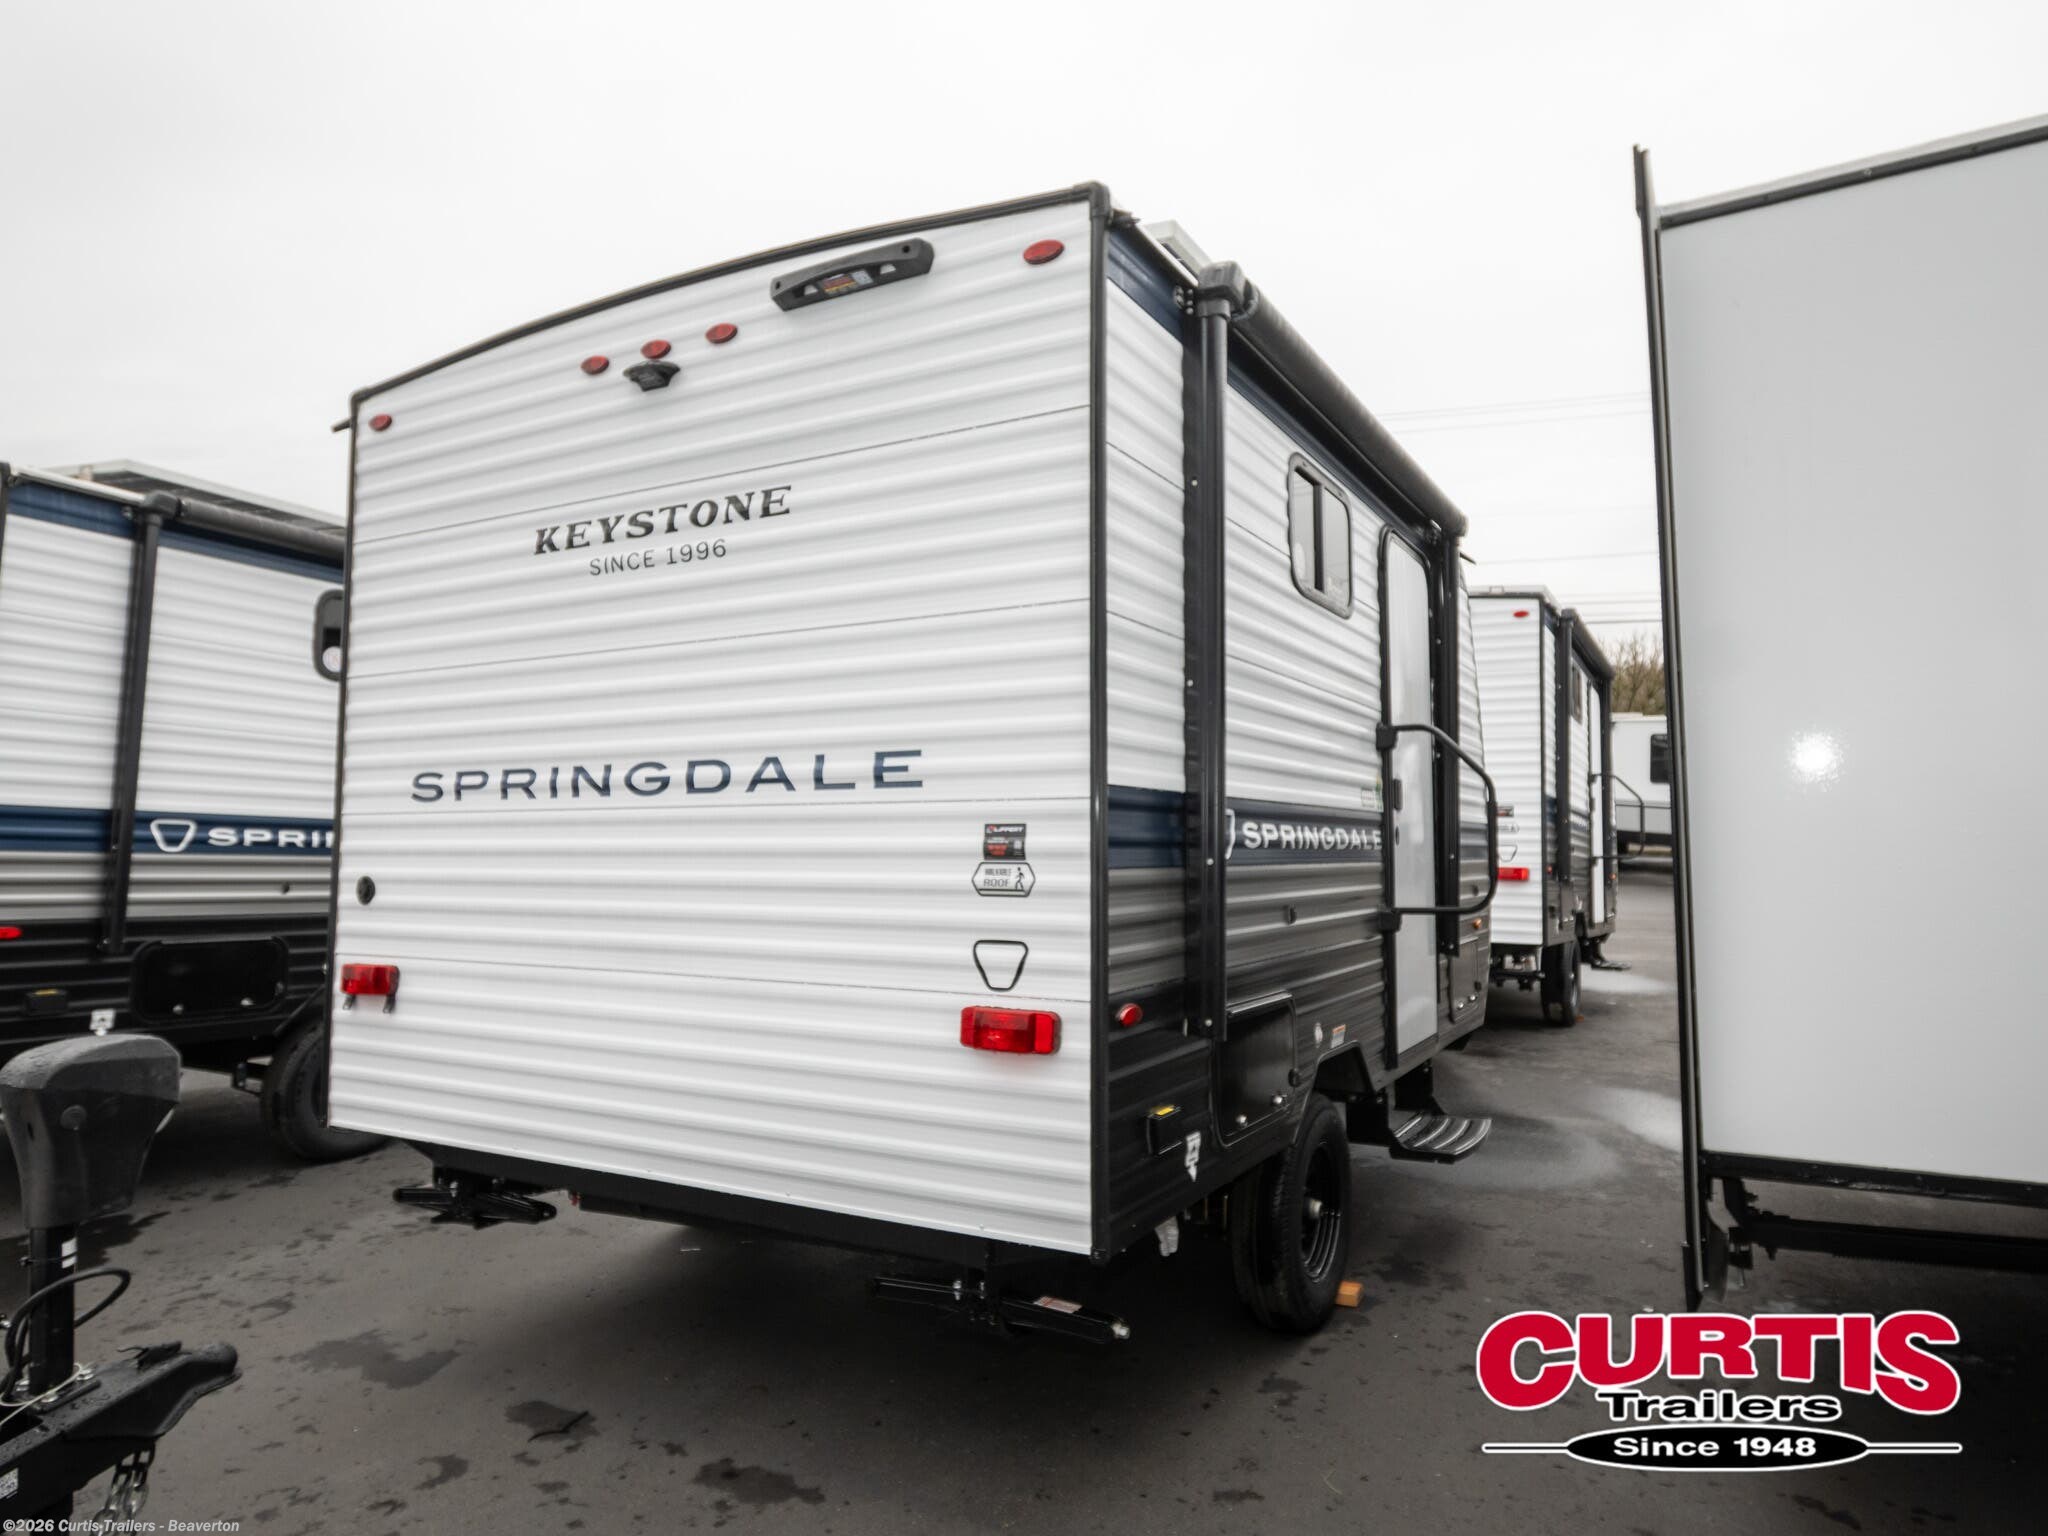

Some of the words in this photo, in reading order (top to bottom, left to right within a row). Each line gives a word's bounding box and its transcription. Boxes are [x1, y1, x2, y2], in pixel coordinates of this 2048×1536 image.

[533, 485, 792, 555] KEYSTONE
[589, 549, 655, 576] SINCE
[666, 538, 727, 565] 1996
[410, 749, 924, 802] SPRINGDALE
[1241, 821, 1383, 850] SPRINGDALE
